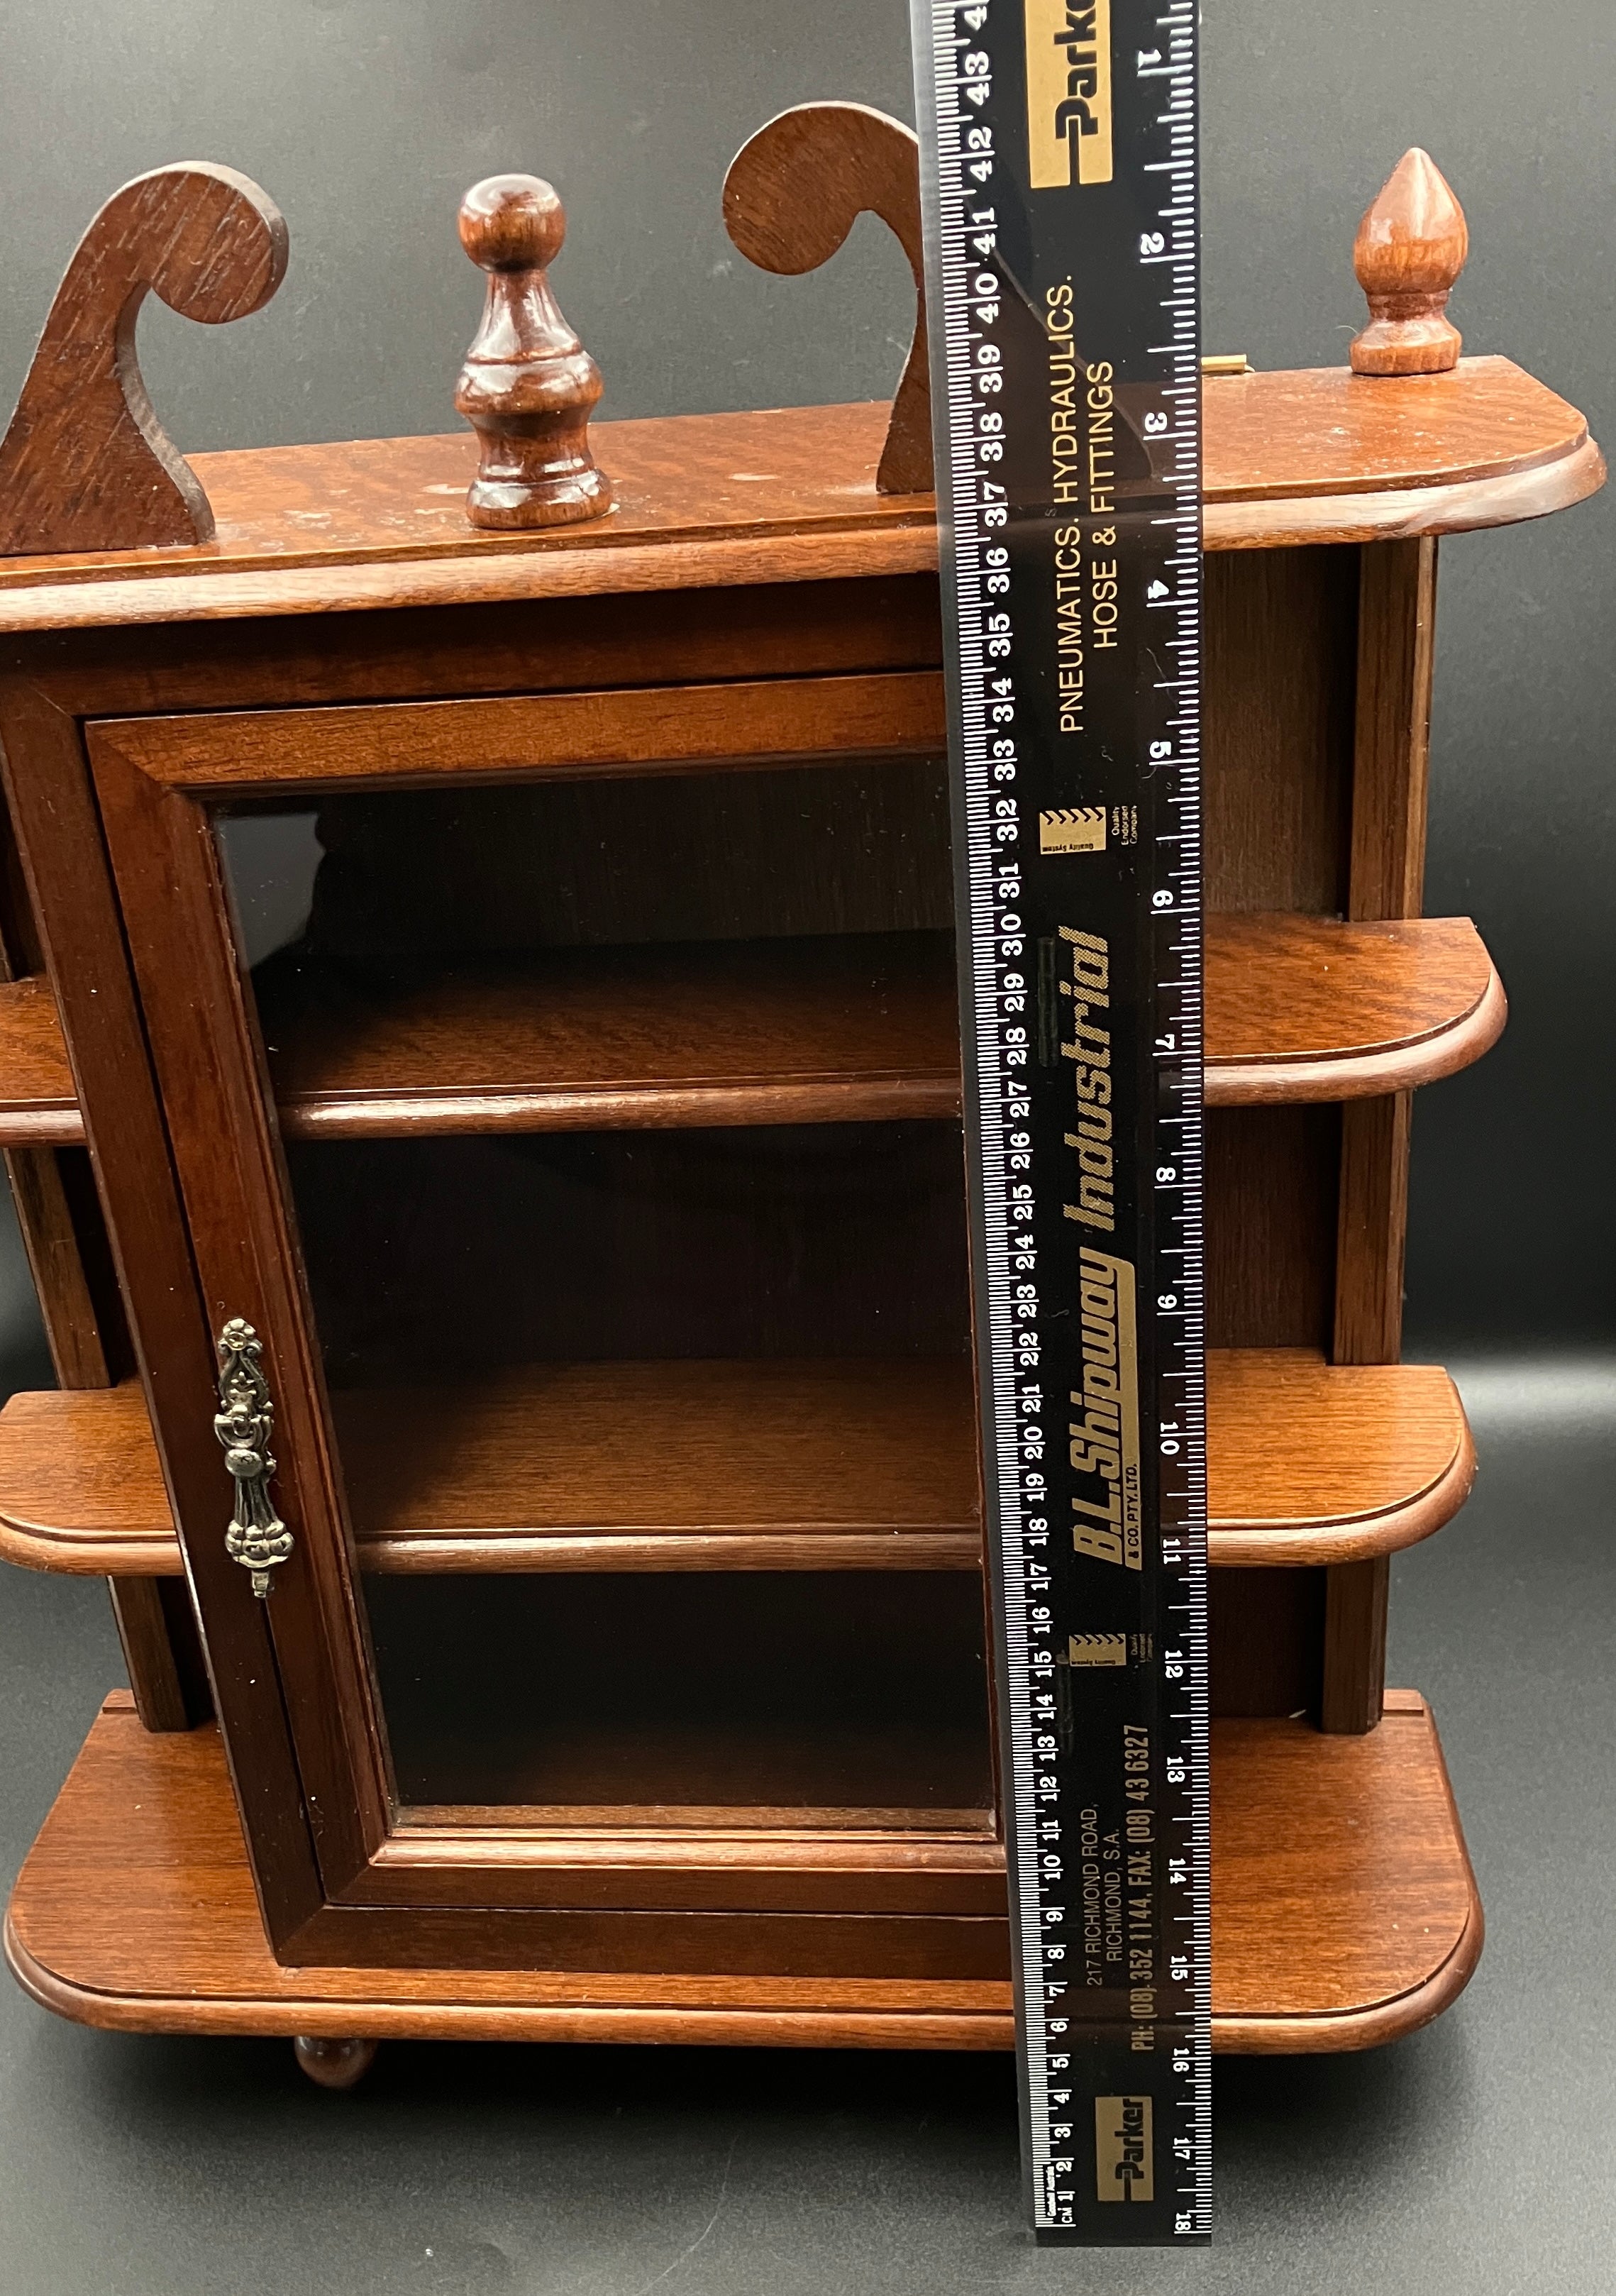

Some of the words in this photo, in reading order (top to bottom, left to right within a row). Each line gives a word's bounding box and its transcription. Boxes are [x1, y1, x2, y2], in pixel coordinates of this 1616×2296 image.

[1053, 0, 1098, 139] Park
[1138, 49, 1162, 67] 1
[965, 51, 990, 106] 43
[968, 126, 992, 182] 42
[972, 207, 995, 255] 41
[1140, 232, 1164, 255] 2
[975, 273, 999, 324] 40
[977, 344, 1002, 394] 39
[1046, 275, 1078, 502] HYDRAULICS.
[980, 412, 1005, 461] 38
[1087, 361, 1115, 513] FITTINGS
[1144, 412, 1167, 433] 3
[983, 482, 1007, 527] 37
[1092, 526, 1117, 545] &
[986, 547, 1009, 593] 36
[1092, 559, 1118, 648] HOSE
[1148, 580, 1170, 599] 4
[988, 613, 1011, 658] 35
[1054, 517, 1084, 732] PNEUMATICS.
[992, 678, 1014, 722] 34
[993, 738, 1016, 781] 33
[1150, 741, 1171, 759] 5
[995, 798, 1019, 841] 32
[1111, 807, 1119, 835] Quality
[998, 863, 1020, 899] 31
[1152, 889, 1173, 907] 6
[1000, 913, 1023, 956] 30
[1003, 973, 1025, 1012] 29
[1005, 1027, 1027, 1066] 28
[1156, 1034, 1175, 1049] 7
[1058, 925, 1114, 1231] Industrial
[1008, 1081, 1029, 1118] 27
[1010, 1131, 1031, 1170] 26
[1156, 1166, 1177, 1181] 8
[1012, 1183, 1033, 1221] 25
[1014, 1234, 1035, 1270] 24
[1016, 1283, 1036, 1319] 23
[1157, 1294, 1178, 1310] 9
[1019, 1331, 1039, 1366] 22
[1022, 1384, 1041, 1413] 21
[1023, 1425, 1044, 1459] 20
[1159, 1420, 1180, 1456] 10
[1025, 1473, 1046, 1502] 19
[1125, 1464, 1137, 1491] LTD.
[1126, 1494, 1138, 1522] PTY.
[1028, 1518, 1048, 1546] 18
[1127, 1525, 1139, 1547] CO.
[1163, 1538, 1181, 1564] 11
[1029, 1562, 1050, 1591] 17
[1032, 1606, 1051, 1634] 16
[1034, 1650, 1053, 1678] 15
[1165, 1650, 1184, 1679] 12
[1036, 1694, 1055, 1721] 14
[1037, 1735, 1056, 1761] 13
[1124, 1725, 1149, 1771] 6327
[1166, 1756, 1185, 1783] 13
[1040, 1776, 1058, 1801] 12
[1125, 1778, 1149, 1801] 43
[1041, 1820, 1059, 1840] 11
[1080, 1803, 1100, 1856] ROAD,
[1125, 1809, 1155, 1843] (08)
[1103, 1828, 1121, 1861] S.A.
[1044, 1855, 1062, 1880] 10
[1127, 1850, 1151, 1885] FAX:
[1169, 1858, 1187, 1885] 14
[1046, 1911, 1063, 1922] 9
[1082, 1862, 1102, 1953] RICHMOND
[1104, 1867, 1124, 1961] RICHMOND,
[1128, 1892, 1154, 1941] 1144,
[1047, 1948, 1065, 1960] 8
[1129, 1948, 1153, 1980] 352
[1171, 1955, 1188, 1981] 15
[1086, 1960, 1102, 1986] 217
[1048, 1985, 1066, 1997] 7
[1050, 2021, 1068, 2032] 6
[1131, 2025, 1154, 2051] PH:
[1052, 2057, 1069, 2069] 5
[1173, 2048, 1190, 2072] 16
[1053, 2092, 1070, 2104] 4
[1054, 2126, 1072, 2138] 3
[1114, 2098, 1144, 2180] Parker
[1173, 2137, 1190, 2160] 17
[1056, 2161, 1072, 2172] 2
[1175, 2213, 1191, 2231] 18
